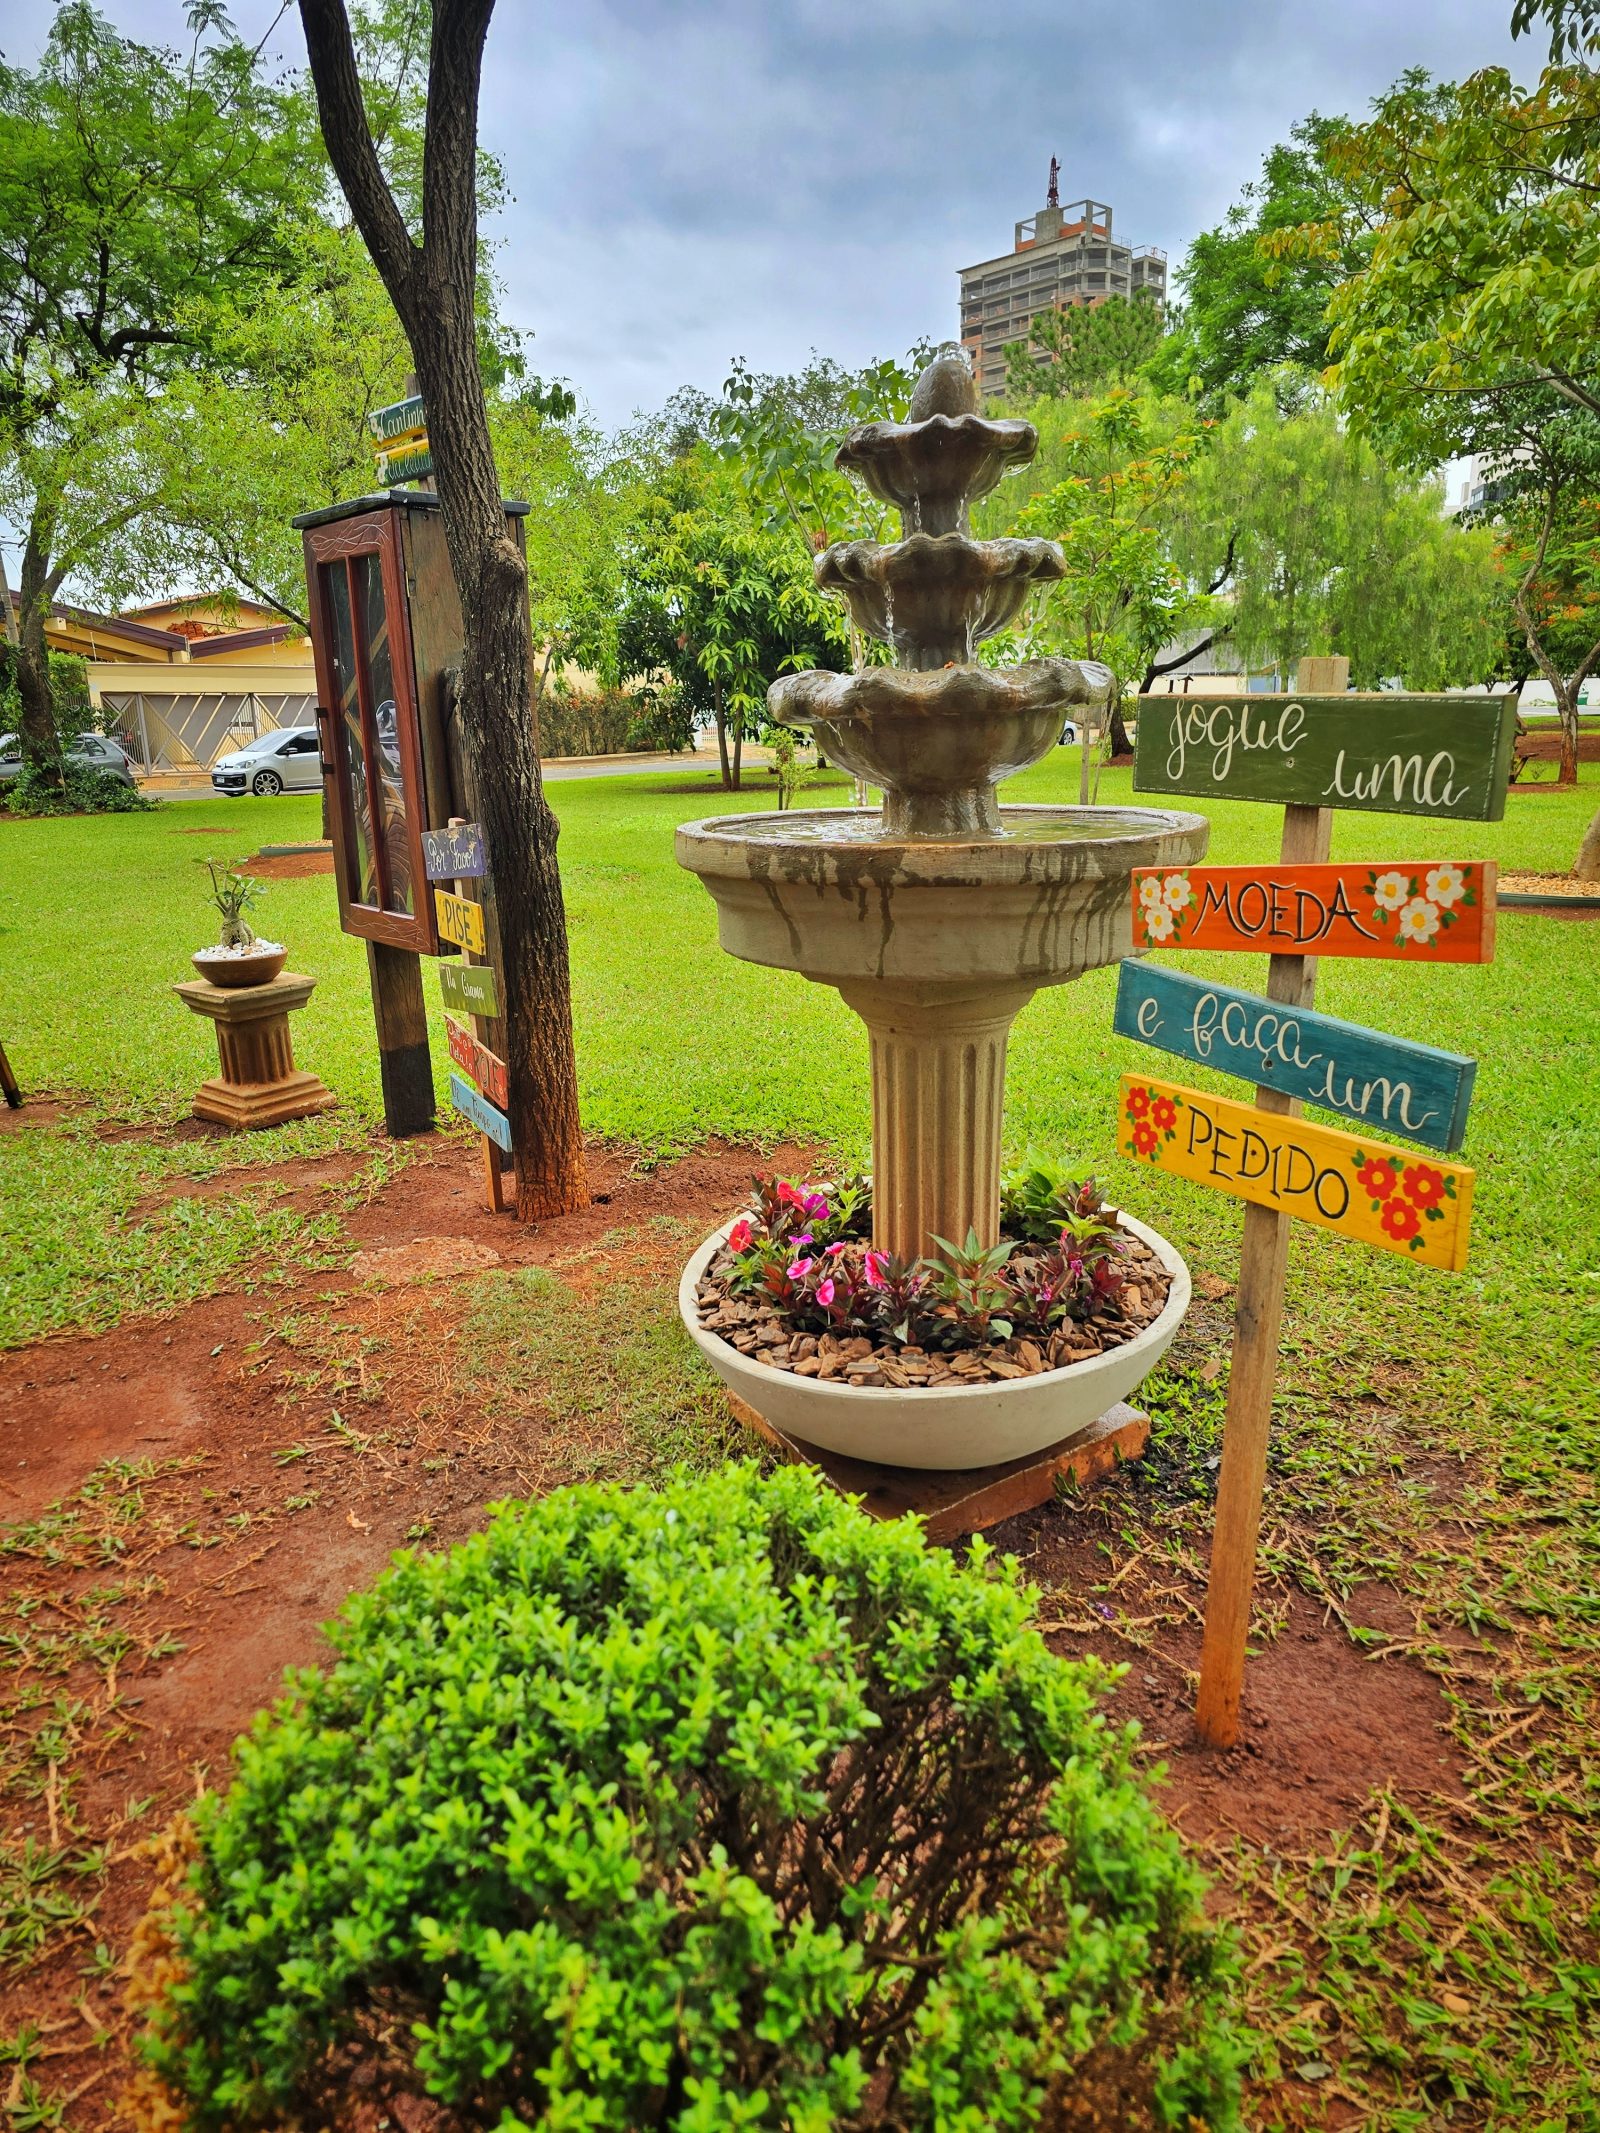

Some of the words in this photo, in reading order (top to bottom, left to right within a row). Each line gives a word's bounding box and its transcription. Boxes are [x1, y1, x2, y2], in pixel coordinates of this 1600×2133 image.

[380, 405, 427, 439] Cantinh
[1321, 749, 1470, 807] uma
[444, 897, 474, 946] PISE
[1191, 877, 1379, 944] MOEDA
[1136, 997, 1165, 1038] e
[1184, 992, 1323, 1071] faça
[1308, 1059, 1440, 1130] um
[1187, 1104, 1349, 1219] PEDIDO
